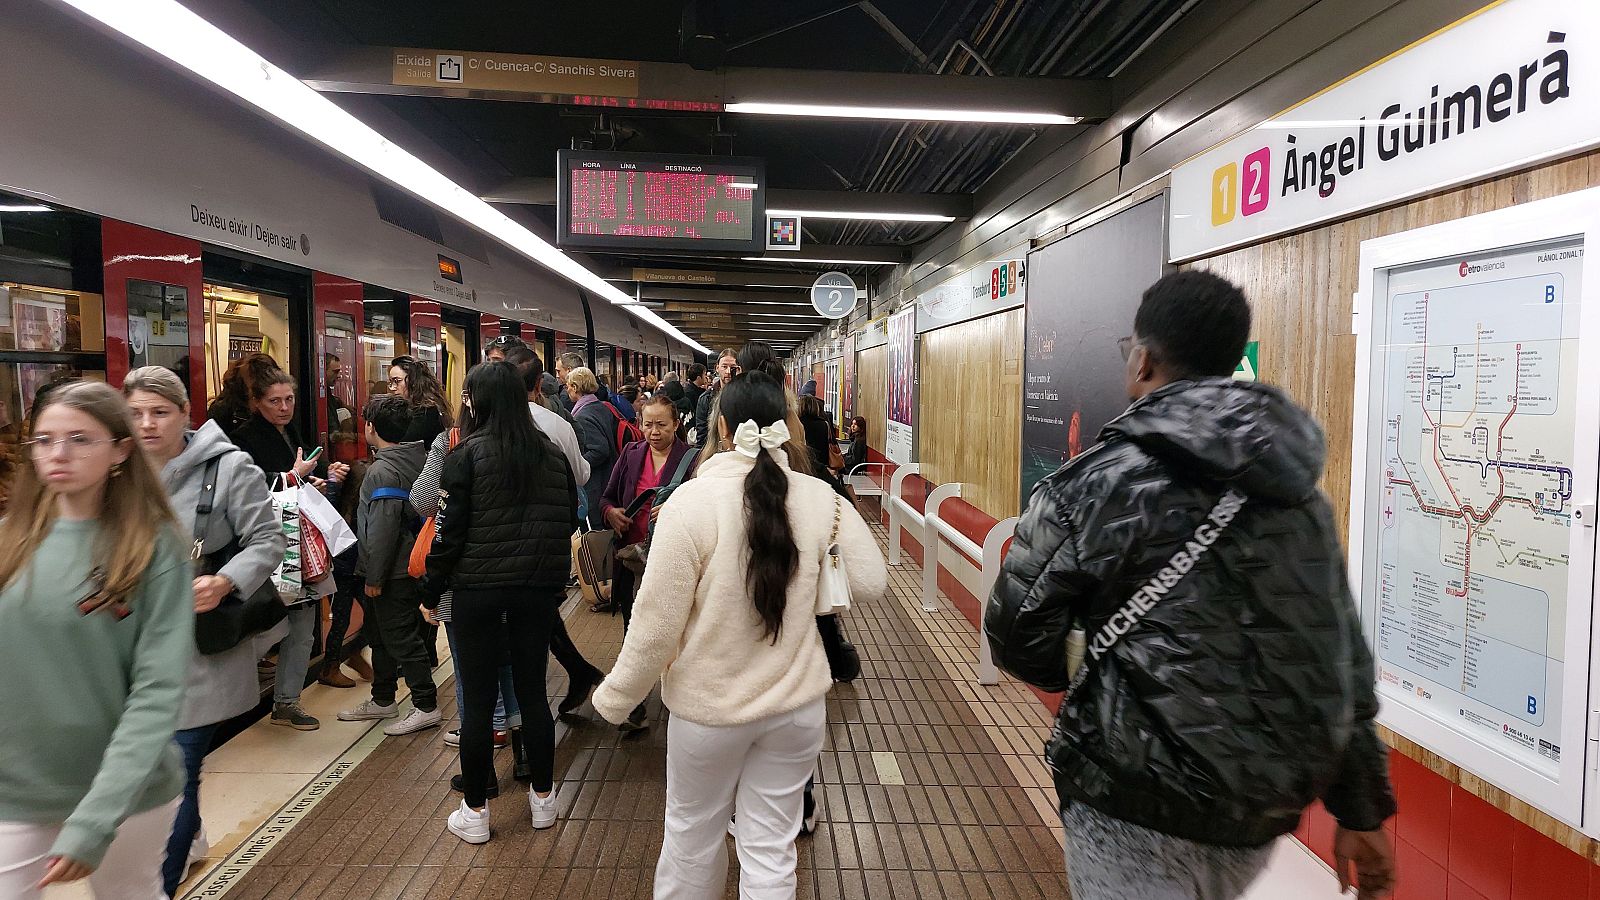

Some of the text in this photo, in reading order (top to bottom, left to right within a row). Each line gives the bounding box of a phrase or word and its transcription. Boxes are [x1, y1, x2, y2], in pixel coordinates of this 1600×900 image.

[396, 54, 432, 67] Eixida
[407, 69, 432, 79] Salida
[599, 65, 636, 79] Sivera
[1281, 30, 1570, 198] Àngel Guimerà
[582, 161, 601, 169] HORA
[664, 163, 702, 173] DESTINACIÓ
[1218, 160, 1262, 216] 1 2
[190, 204, 297, 251] Deixeu eixir / Dejen salir
[1537, 252, 1558, 263] PLÀNOL
[1559, 250, 1578, 260] ZONAL
[828, 289, 843, 312] 2
[1545, 285, 1555, 304] B
[228, 340, 238, 351] TS
[1527, 695, 1537, 715] B
[286, 796, 313, 814] tren
[277, 815, 296, 828] el
[268, 826, 285, 837] si
